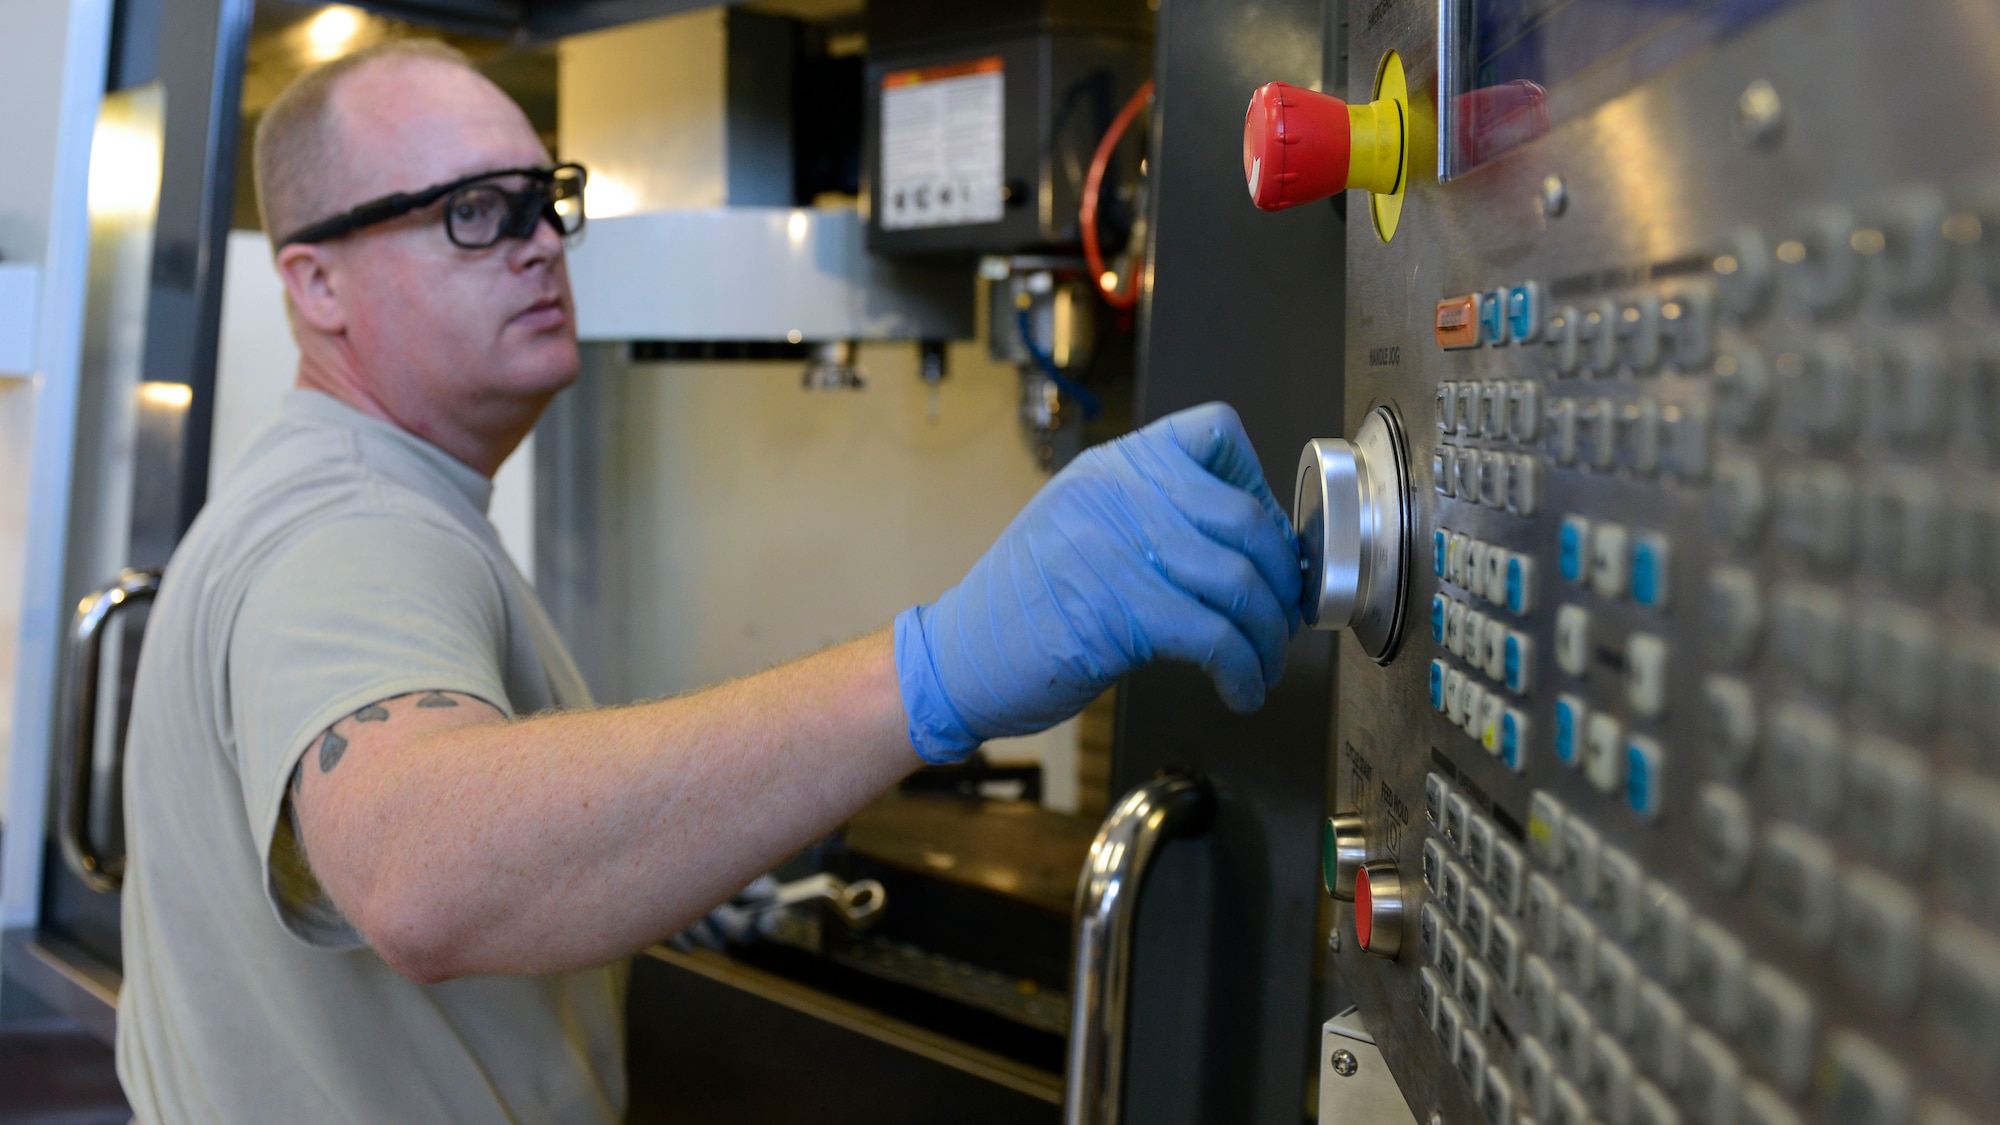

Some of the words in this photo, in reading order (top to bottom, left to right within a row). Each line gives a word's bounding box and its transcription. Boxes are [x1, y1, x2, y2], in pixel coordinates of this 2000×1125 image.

[1369, 347, 1388, 366] HANDLE
[1389, 346, 1400, 366] JOG
[1382, 780, 1393, 808] FEED
[1393, 793, 1409, 826] HOLD
